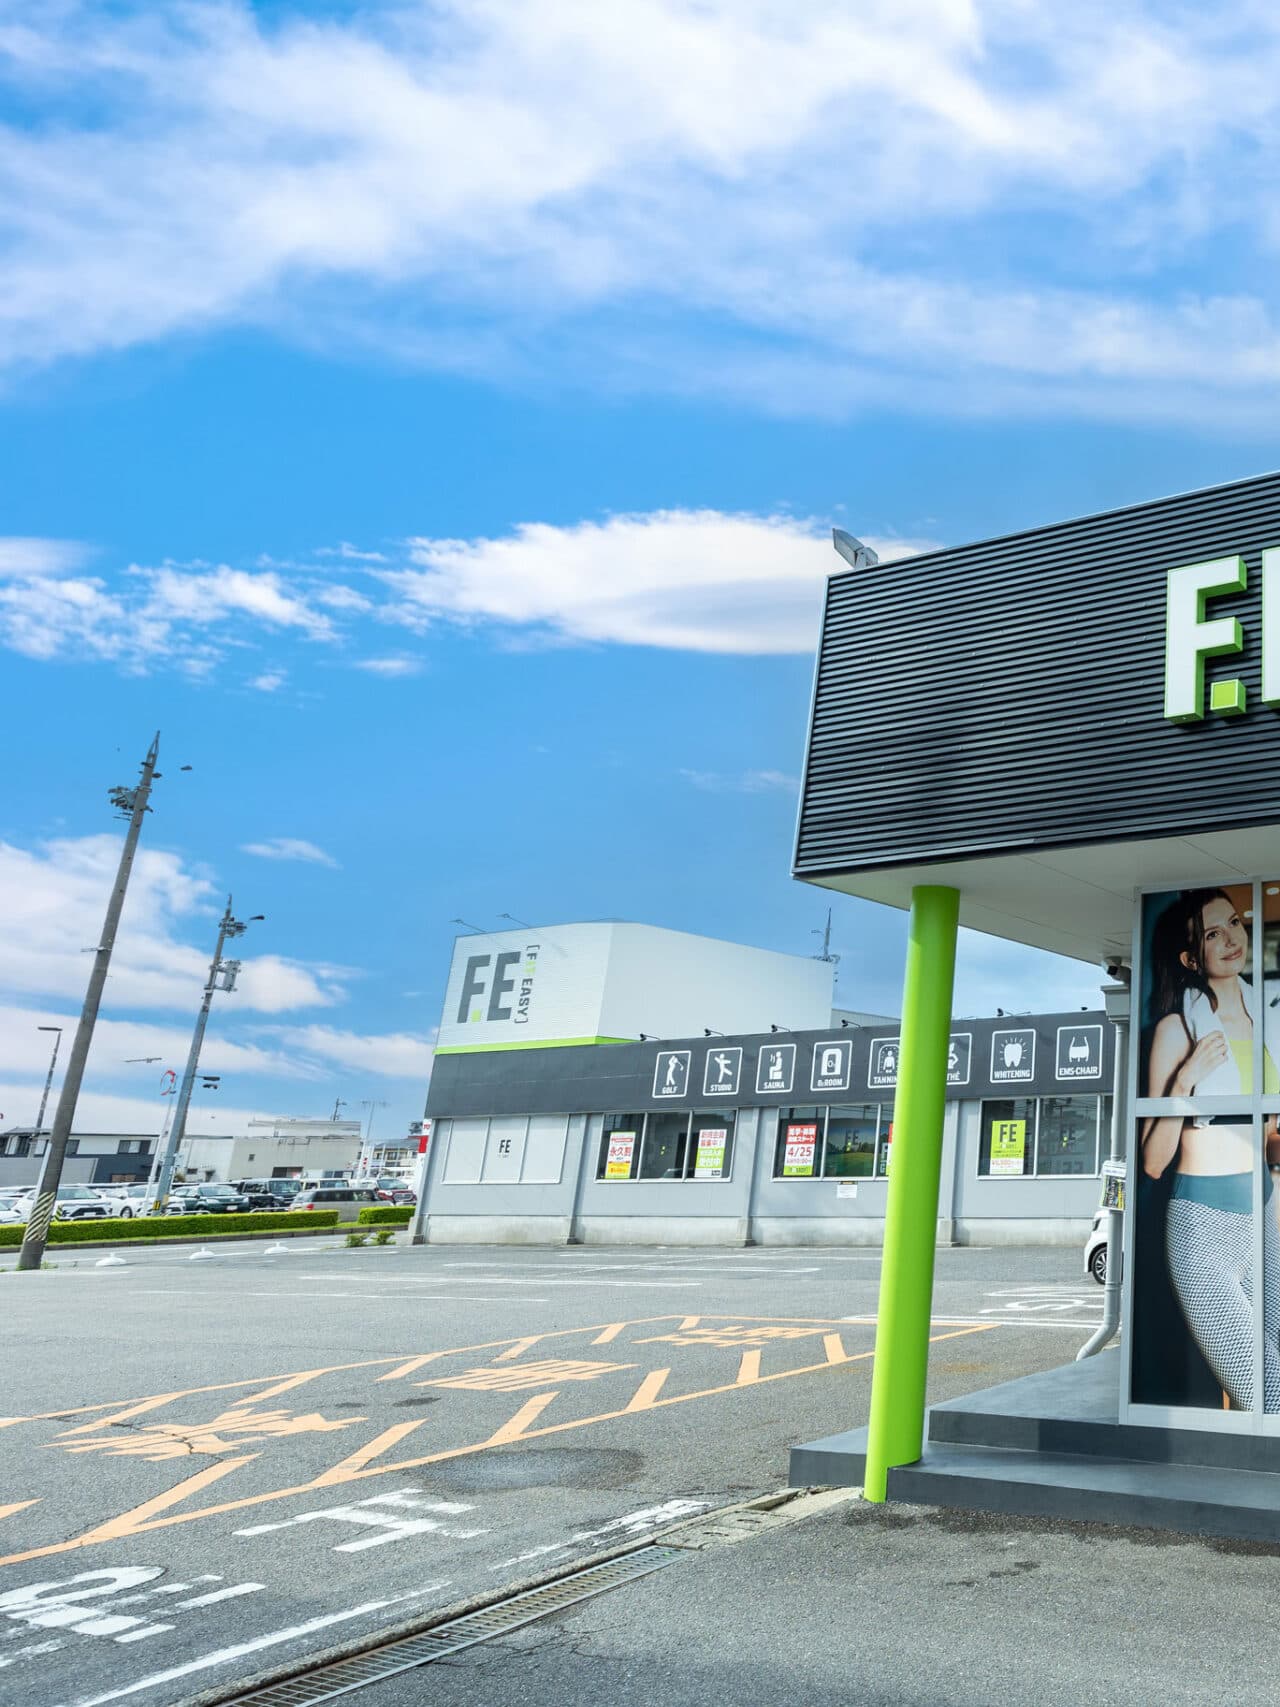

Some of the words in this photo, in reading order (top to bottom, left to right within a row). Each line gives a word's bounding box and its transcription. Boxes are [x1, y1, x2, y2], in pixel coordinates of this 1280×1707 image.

[994, 1069, 1031, 1079] WHITENING
[1059, 1066, 1098, 1076] EMS-CHAIR
[710, 1084, 732, 1092] STUDIO
[763, 1081, 785, 1089] SAUNA
[662, 1086, 678, 1094] GOLF
[788, 1147, 812, 1157] 4/25
